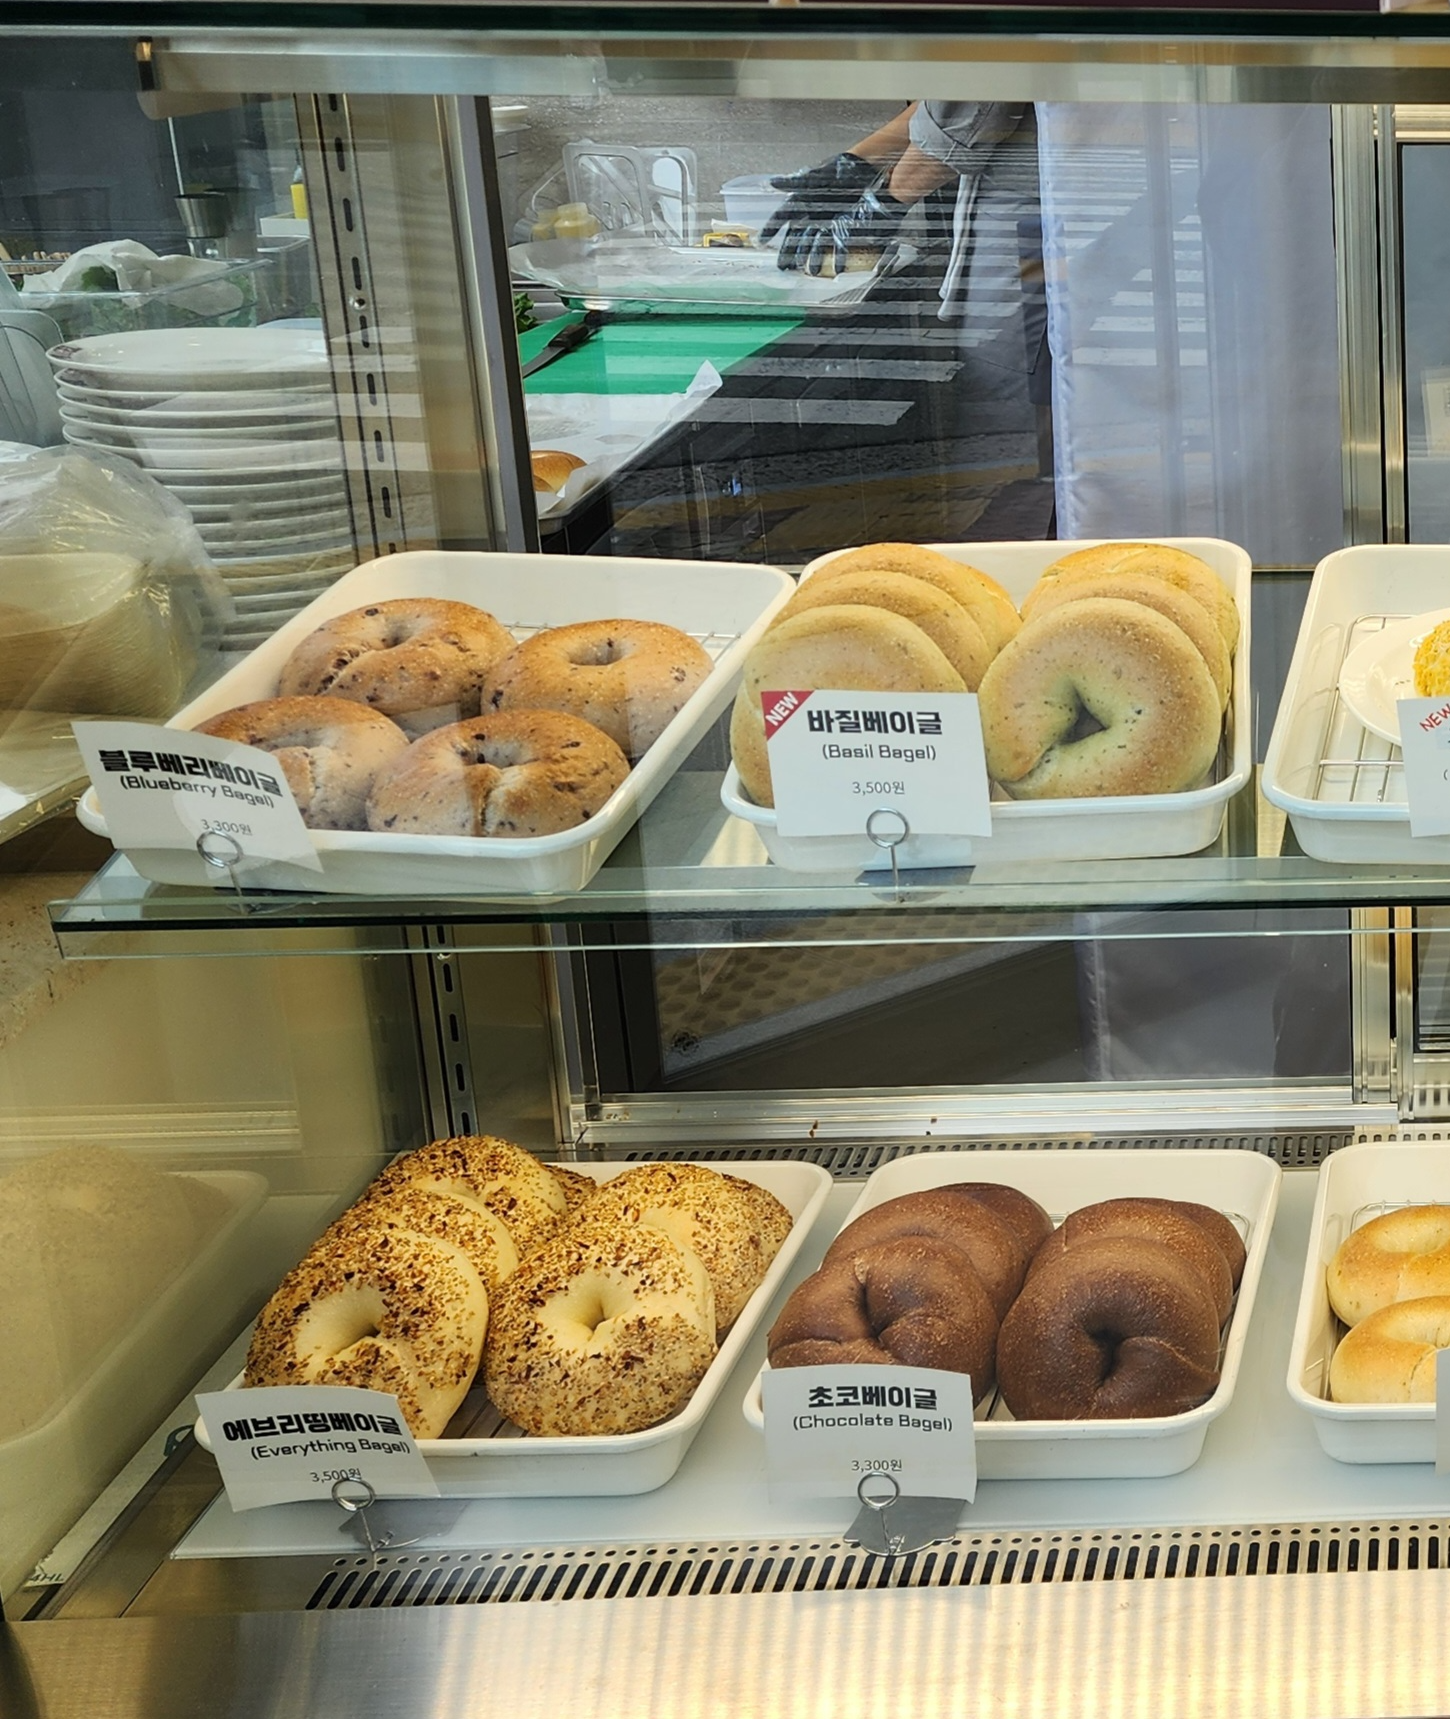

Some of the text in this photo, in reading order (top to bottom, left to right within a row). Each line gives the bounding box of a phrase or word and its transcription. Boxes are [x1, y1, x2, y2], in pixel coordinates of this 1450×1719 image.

[765, 691, 800, 727] NEW
[806, 709, 943, 735] 바질베이글
[821, 744, 937, 763] (Basil Bagel)
[98, 749, 284, 798] 블루베리베이글
[119, 774, 275, 808] (Blueberry Bagel)
[852, 781, 905, 795] 3,500원
[201, 818, 253, 837] 3,300원
[807, 1385, 938, 1411] 초코베이글
[222, 1412, 403, 1441] 에브리띵베이글
[792, 1413, 954, 1432] (Chocolate Bagel)
[250, 1438, 411, 1460] (Everything Bagel)
[310, 1467, 362, 1484] 3,500원
[851, 1459, 903, 1473] 3,300원
